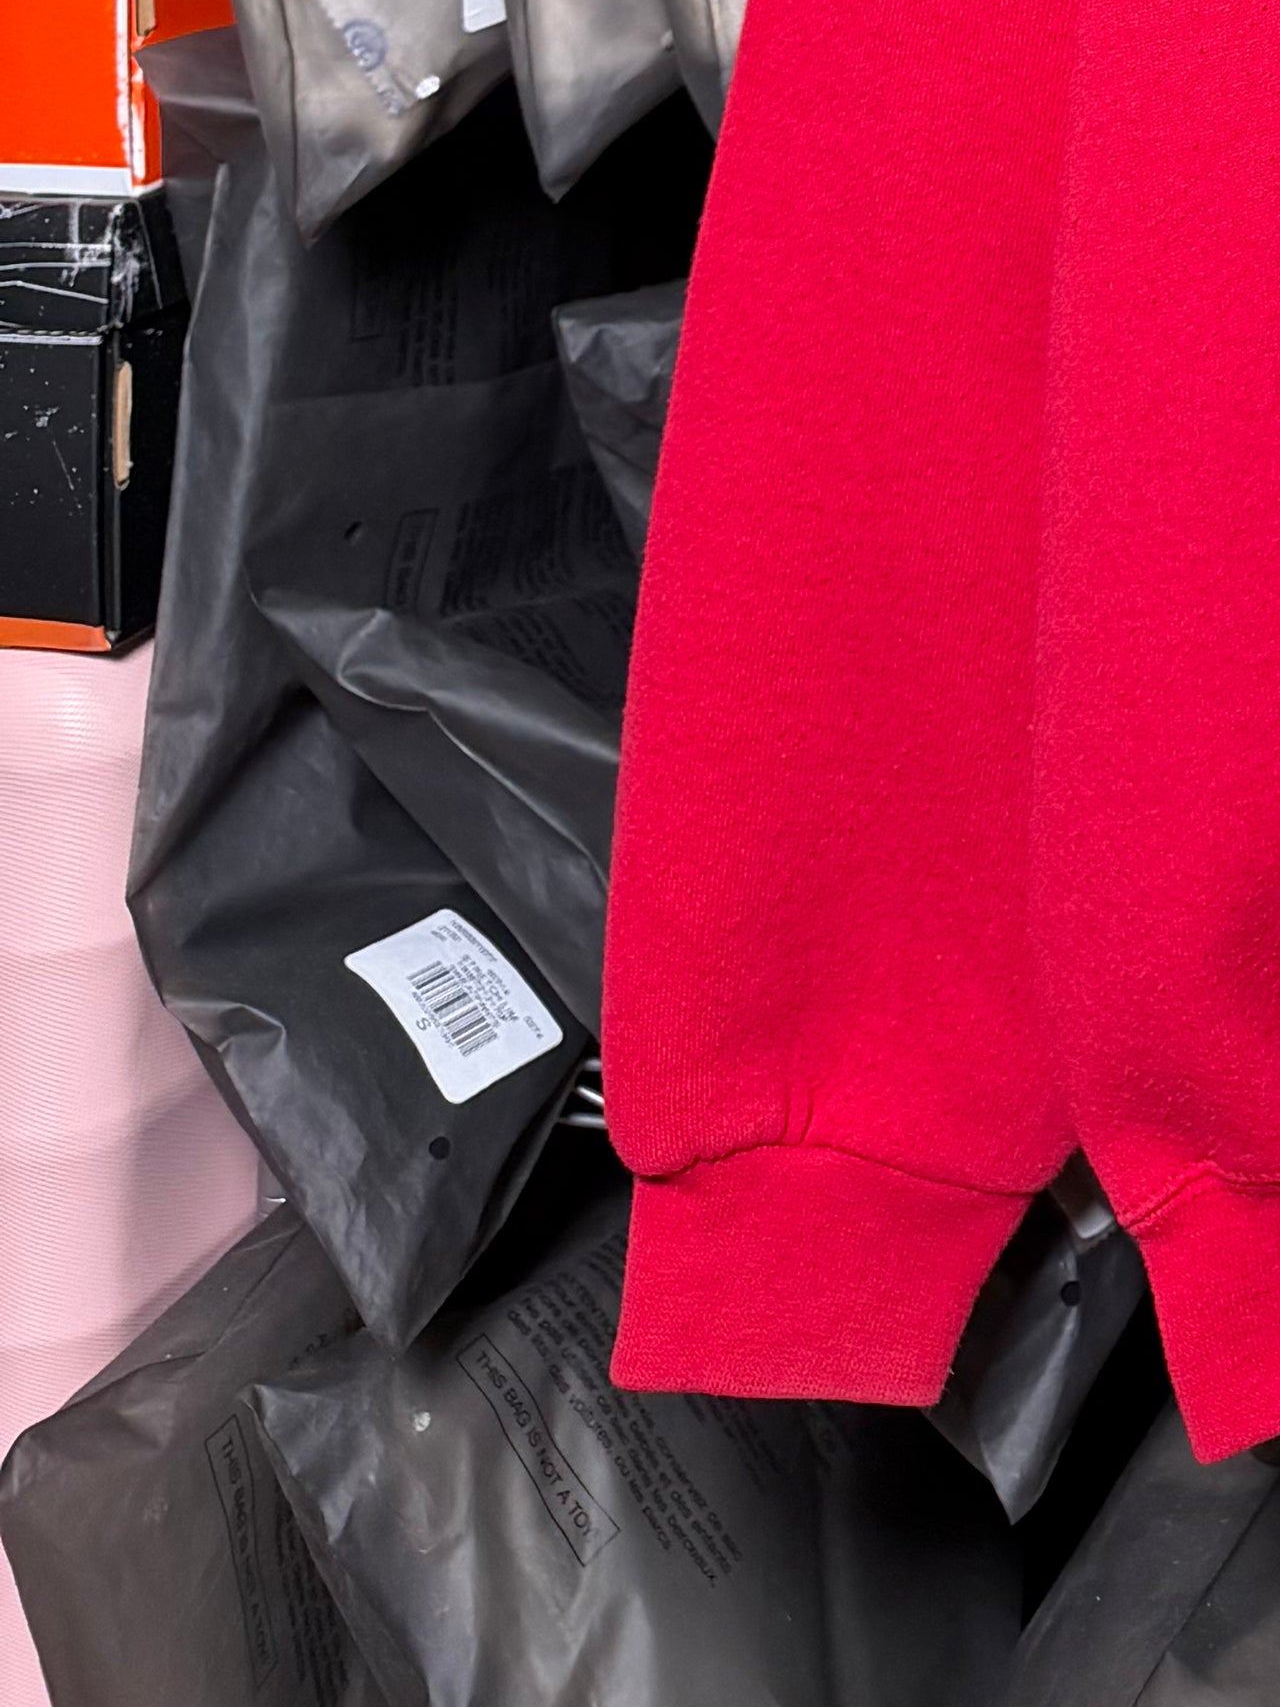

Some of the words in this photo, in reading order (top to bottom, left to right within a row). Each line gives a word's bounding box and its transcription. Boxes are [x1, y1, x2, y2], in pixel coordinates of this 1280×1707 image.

[415, 1017, 431, 1032] S
[476, 1350, 508, 1389] THIS
[503, 1387, 532, 1428] BAG
[526, 1427, 542, 1448] IS
[538, 1448, 564, 1487] NOT
[556, 1489, 571, 1505] A
